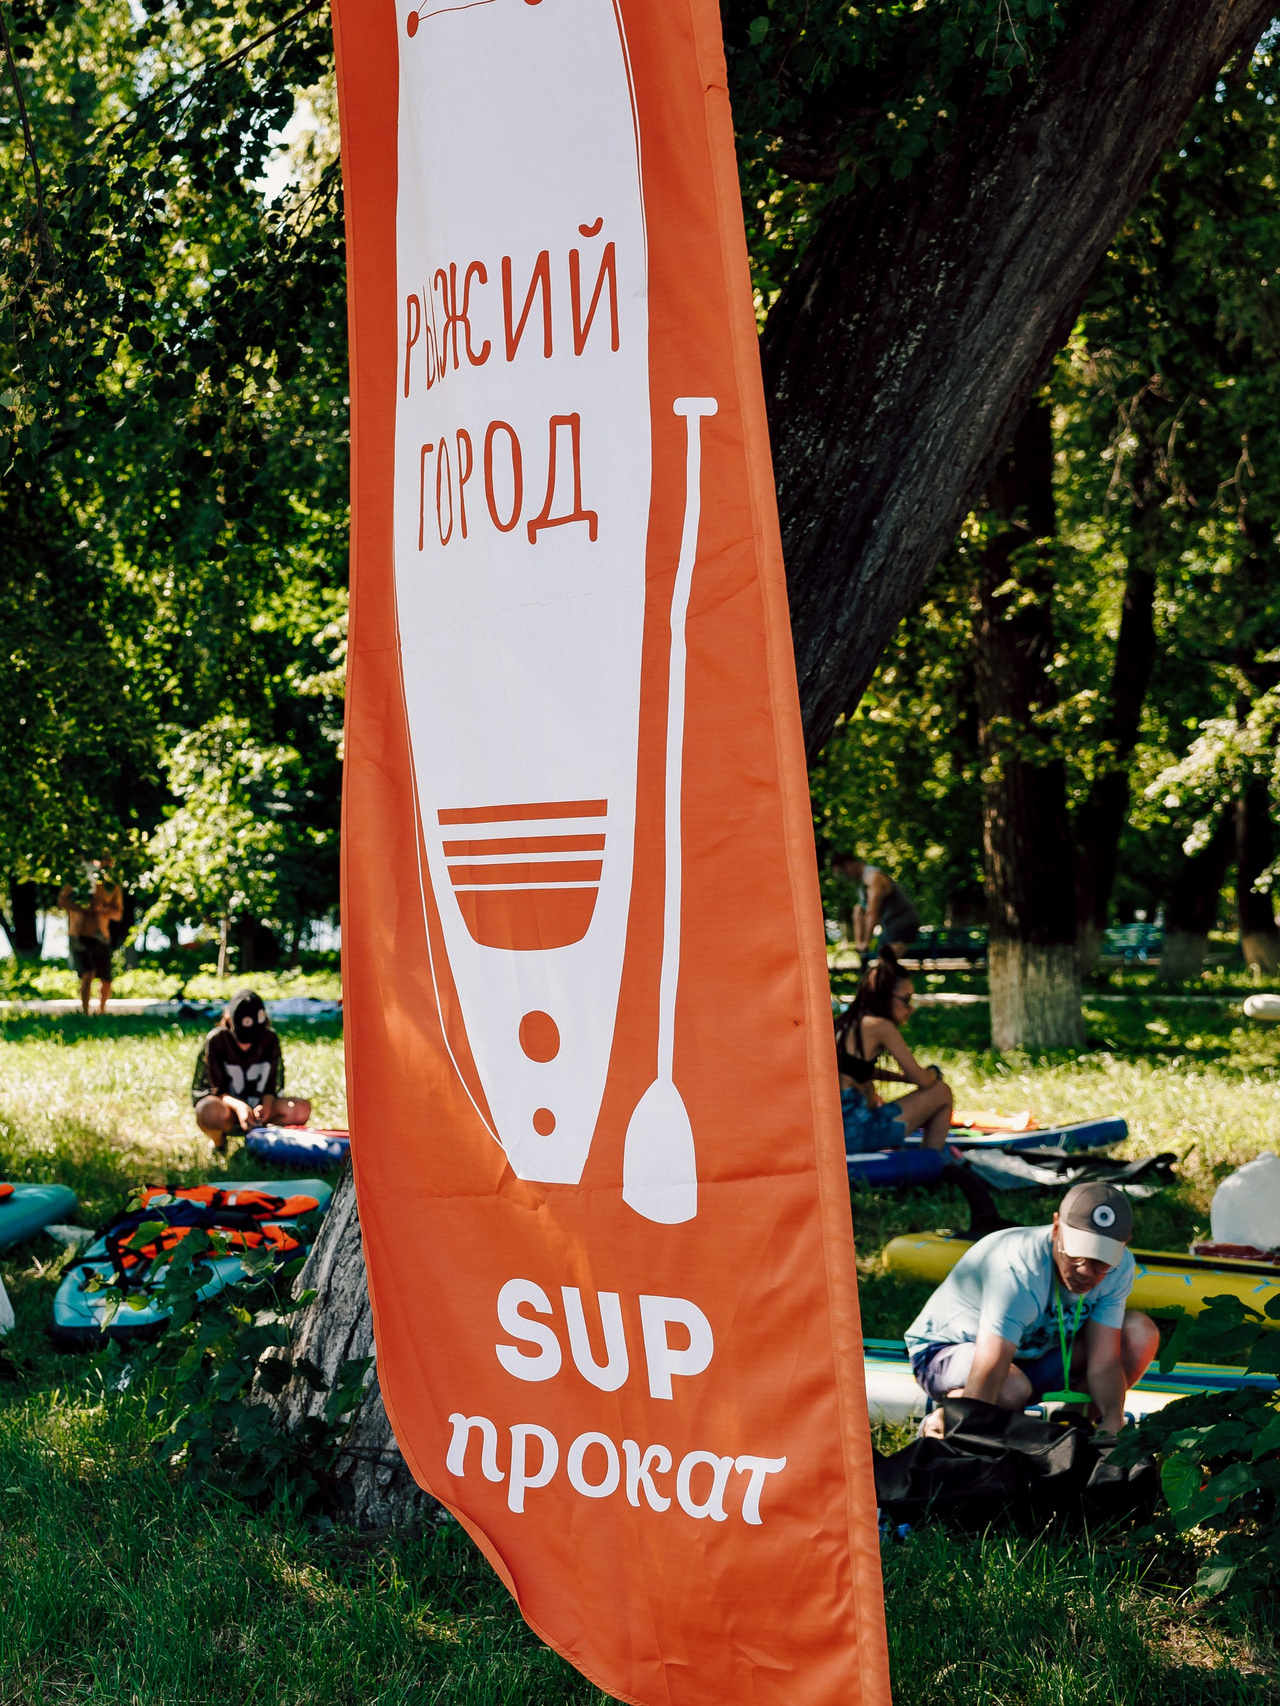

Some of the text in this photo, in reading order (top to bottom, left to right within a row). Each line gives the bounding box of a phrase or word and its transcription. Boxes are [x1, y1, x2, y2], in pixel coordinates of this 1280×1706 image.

[404, 217, 620, 398] РЫЖИЙ
[418, 412, 599, 551] ГОРОД
[495, 1278, 715, 1401] SUP
[445, 1412, 787, 1525] прокат
